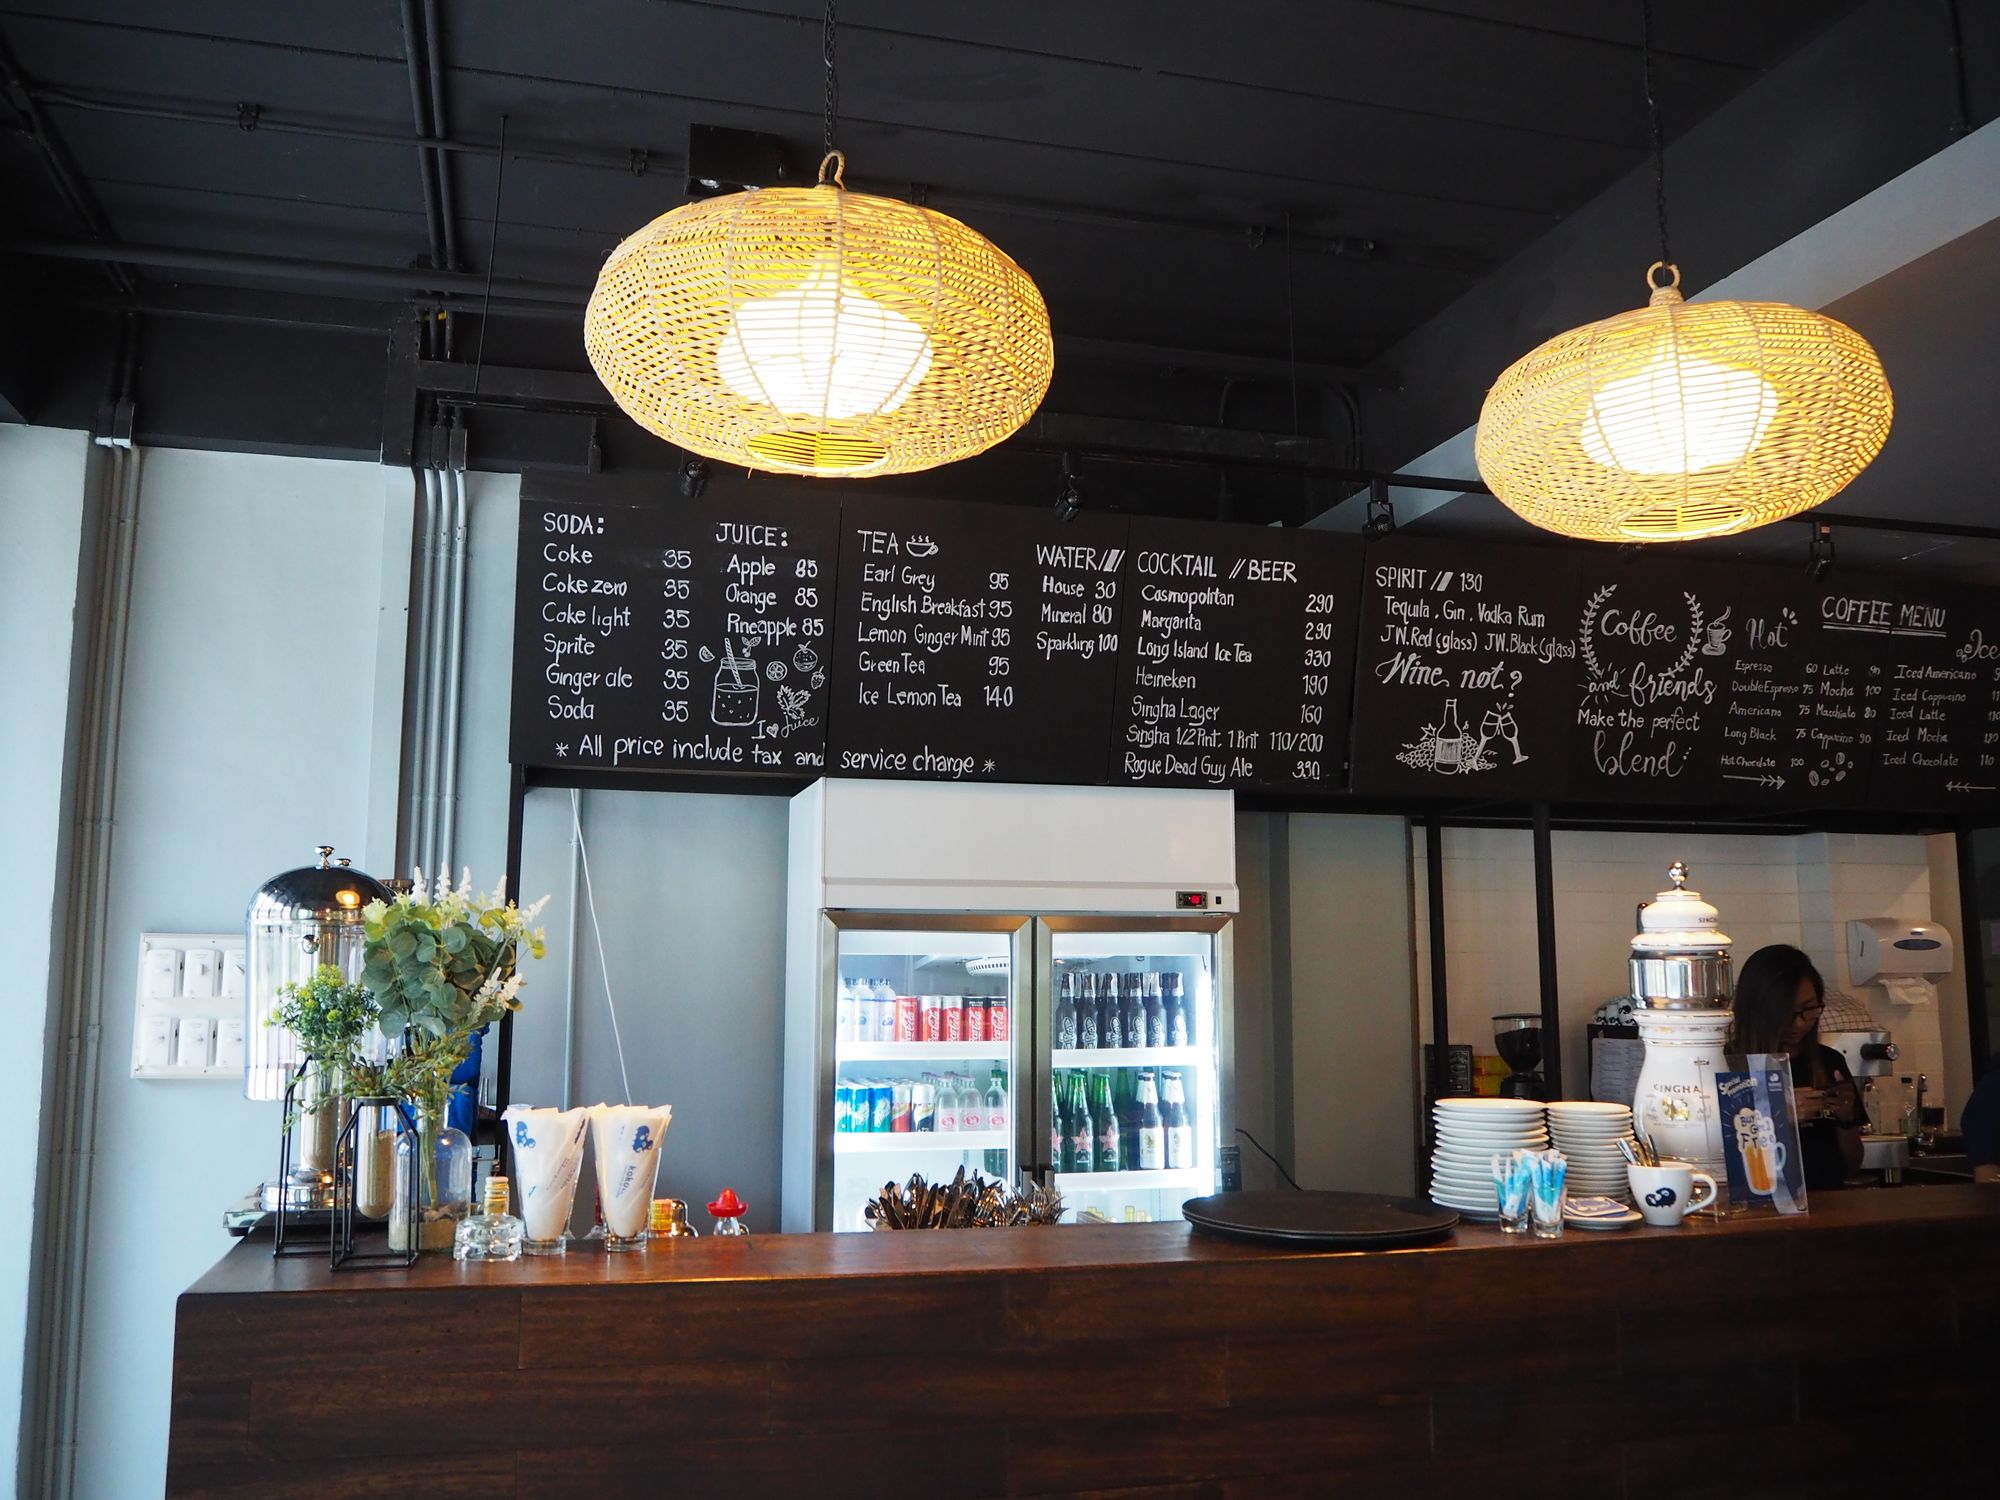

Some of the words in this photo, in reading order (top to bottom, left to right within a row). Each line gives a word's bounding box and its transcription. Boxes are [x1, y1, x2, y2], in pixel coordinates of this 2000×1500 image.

[544, 513, 604, 534] SODA:
[716, 523, 788, 546] JUICE:
[544, 543, 592, 564] Coke
[663, 550, 691, 569] 35
[857, 530, 898, 555] TEA
[727, 554, 775, 585] Apple
[795, 559, 817, 577] 85
[1138, 552, 1217, 577] COCKTAIL
[543, 573, 588, 593] Coke
[591, 580, 627, 596] zero
[664, 579, 689, 599] 35
[864, 564, 895, 582] Earl
[902, 566, 934, 593] Grey
[990, 572, 1009, 590] 95
[1043, 576, 1084, 597] House
[1095, 581, 1116, 599] 30
[1376, 567, 1427, 589] SPIRIT
[1460, 573, 1482, 592] 130
[726, 583, 776, 614] Orange
[795, 588, 818, 607] 85
[862, 592, 916, 620] English
[921, 595, 986, 618] Breakfast
[989, 600, 1012, 618] 95
[1142, 585, 1234, 614] Cosmopolitan
[1305, 594, 1333, 613] 290
[543, 602, 586, 624] Coke
[592, 606, 631, 636] light
[663, 609, 690, 628] 35
[1041, 603, 1086, 624] Mineral
[1092, 604, 1112, 624] 80
[1141, 607, 1201, 638] Margarita
[1305, 622, 1331, 640] 290
[1478, 603, 1512, 624] Vodka
[1518, 606, 1545, 627] Rum
[1822, 597, 1892, 626] COFFEE
[1900, 604, 1945, 628] MENU
[728, 613, 796, 649] Pineapple
[802, 618, 823, 636] 85
[858, 622, 906, 643] Lemon
[915, 624, 958, 653] Ginger
[961, 625, 989, 647] Mint
[992, 628, 1010, 646] 95
[1601, 609, 1676, 646] Coffee
[1746, 618, 1787, 648] Hot
[544, 633, 595, 667] Sprite
[661, 639, 687, 659] 35
[1037, 631, 1094, 660] Sparkling
[1099, 634, 1118, 652] 100
[1138, 636, 1169, 664] Long
[1174, 640, 1208, 658] Island
[1215, 643, 1232, 661] Ice
[1234, 643, 1252, 662] Tea
[1305, 649, 1331, 667] 330
[859, 651, 899, 673] Green
[901, 653, 925, 674] Tea
[989, 656, 1009, 675] 95
[1375, 652, 1449, 687] Wine
[1735, 660, 1772, 674] Espresso
[1806, 663, 1818, 673] 60
[1823, 664, 1849, 675] Latte
[1894, 665, 1924, 679] Iced
[1925, 666, 1976, 679] Americano
[546, 661, 600, 695] Ginger
[606, 667, 632, 687] ale
[663, 669, 689, 690] 35
[1136, 666, 1195, 688] Heineken
[1303, 675, 1328, 695] 190
[1587, 667, 1620, 692] and
[1629, 659, 1717, 707] friends
[1732, 680, 1763, 692] Double
[1764, 680, 1798, 701] Espresso
[1803, 684, 1813, 694] 75
[1820, 681, 1854, 697] Mocha
[1865, 685, 1881, 696] 100
[859, 682, 879, 705] Ice
[888, 682, 936, 706] Lemon
[938, 684, 961, 706] Tea
[984, 686, 1013, 707] 140
[1892, 688, 1918, 701] Iced
[548, 695, 594, 719] Soda
[662, 700, 688, 722] 35
[1132, 695, 1175, 724] Singha
[1180, 698, 1220, 726] Lager
[1301, 704, 1322, 725] 160
[1578, 709, 1614, 726] Make
[1618, 709, 1644, 727] the
[1651, 706, 1700, 738] perfect
[1729, 701, 1781, 717] Americano
[1799, 705, 1810, 715] 75
[1864, 707, 1876, 718] 80
[1890, 706, 1914, 720] Iced
[1919, 709, 1945, 721] Latte
[1126, 725, 1169, 748] Singha
[1177, 727, 1196, 745] 1/2
[1228, 730, 1233, 748] 1
[1237, 730, 1259, 749] Pint
[1270, 732, 1323, 752] 110/200
[1725, 727, 1747, 745] Long
[1750, 727, 1776, 740] Black
[1796, 729, 1806, 739] 75
[1887, 728, 1909, 742] Iced
[1918, 728, 1947, 742] Mocha
[579, 735, 602, 757] All
[614, 737, 664, 766] price
[673, 735, 742, 762] include
[752, 744, 782, 765] tax
[794, 742, 825, 766] and
[840, 748, 906, 770] service
[913, 745, 974, 778] charge
[1594, 727, 1682, 777] blend
[1721, 755, 1735, 765] Hot
[1736, 756, 1775, 767] Chocolate
[1883, 752, 1906, 765] Iced
[1912, 752, 1958, 766] Chocolate
[1125, 752, 1161, 779] Rogue
[1165, 754, 1197, 775] Dead
[1201, 755, 1226, 783] Guy
[1230, 757, 1252, 777] Ale
